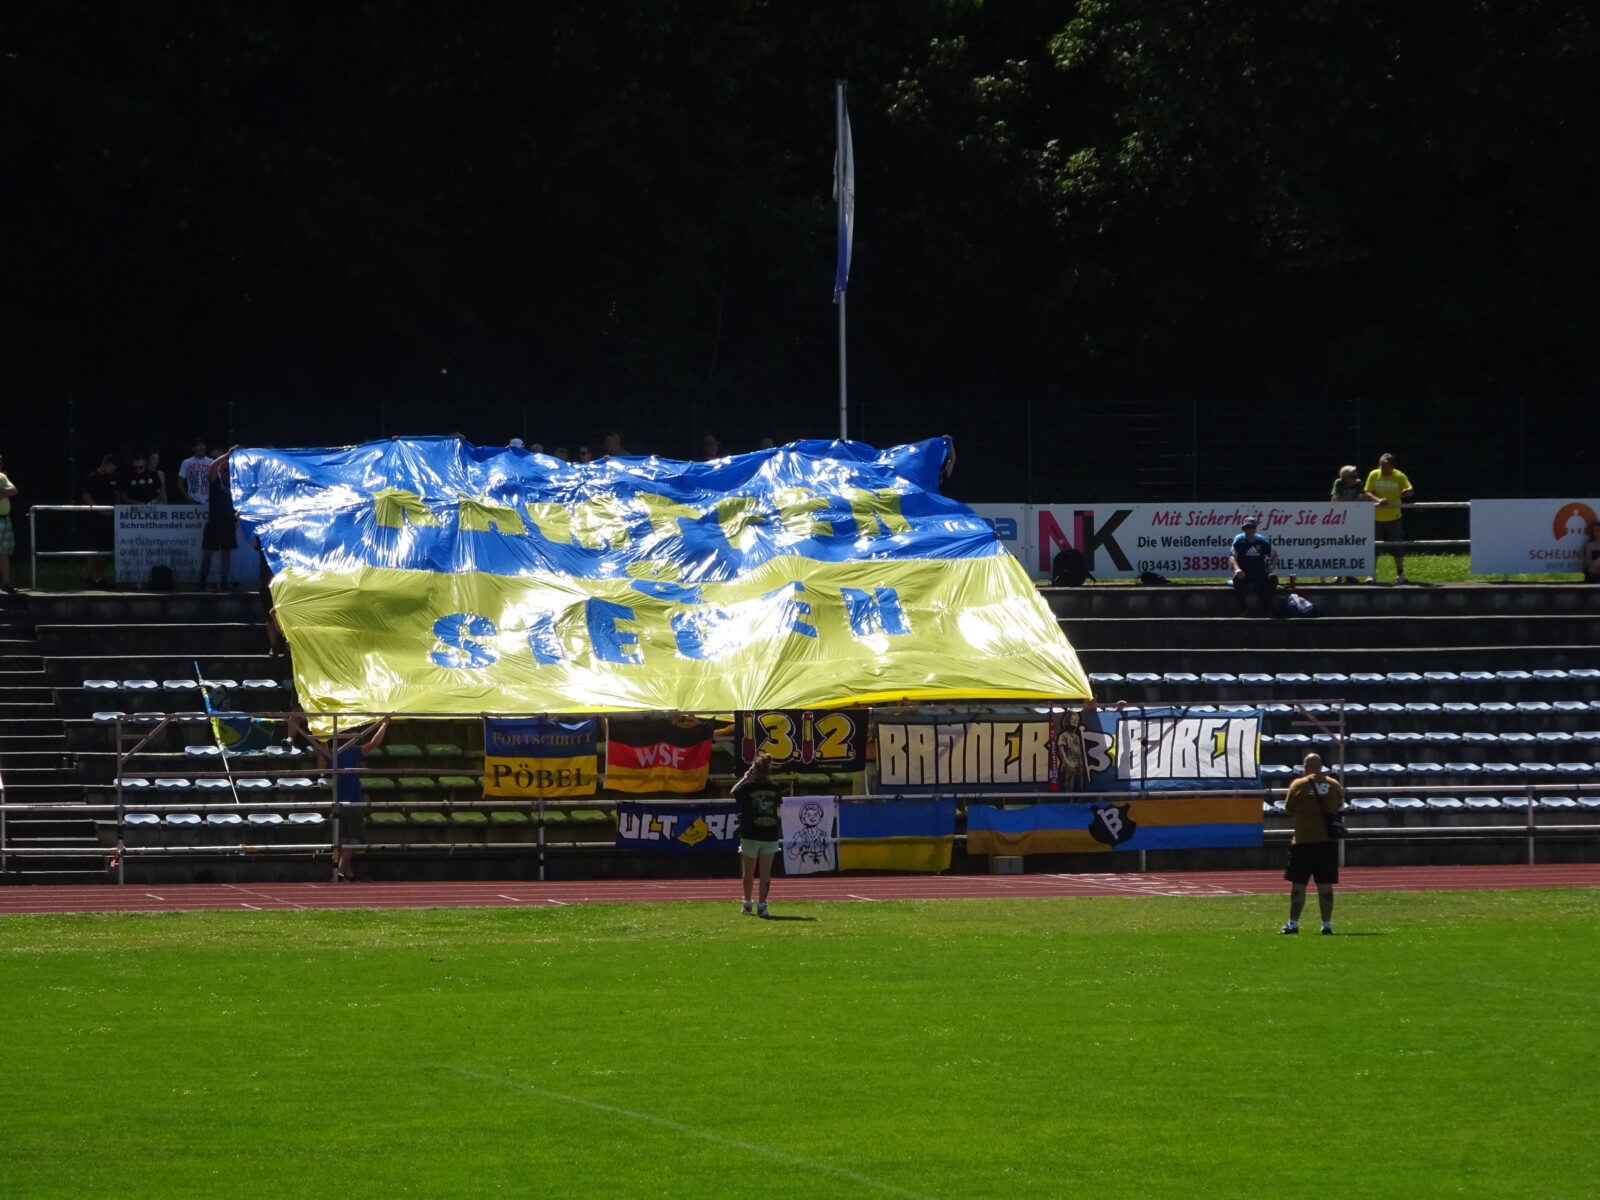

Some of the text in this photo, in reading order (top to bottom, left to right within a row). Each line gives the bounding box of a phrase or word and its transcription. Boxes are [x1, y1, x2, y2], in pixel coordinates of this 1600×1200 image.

[119, 521, 183, 529] Schrotthandel
[171, 510, 210, 520] RECYC
[1151, 510, 1183, 527] Mit
[1262, 507, 1293, 531] für
[1295, 509, 1318, 526] Sie
[1321, 508, 1347, 526] da!
[1038, 510, 1134, 572] NK
[1137, 534, 1368, 549] Die Weißenfelse icherungsmakler
[1137, 559, 1182, 573] (03443)
[1266, 557, 1366, 571] EHLE-KRAMER.DE
[491, 730, 593, 746] FORTSCHRITT
[1117, 717, 1258, 780] BUBEN
[635, 743, 687, 769] WSF
[878, 720, 1050, 785] BANNER
[491, 763, 594, 789] PÖBEL
